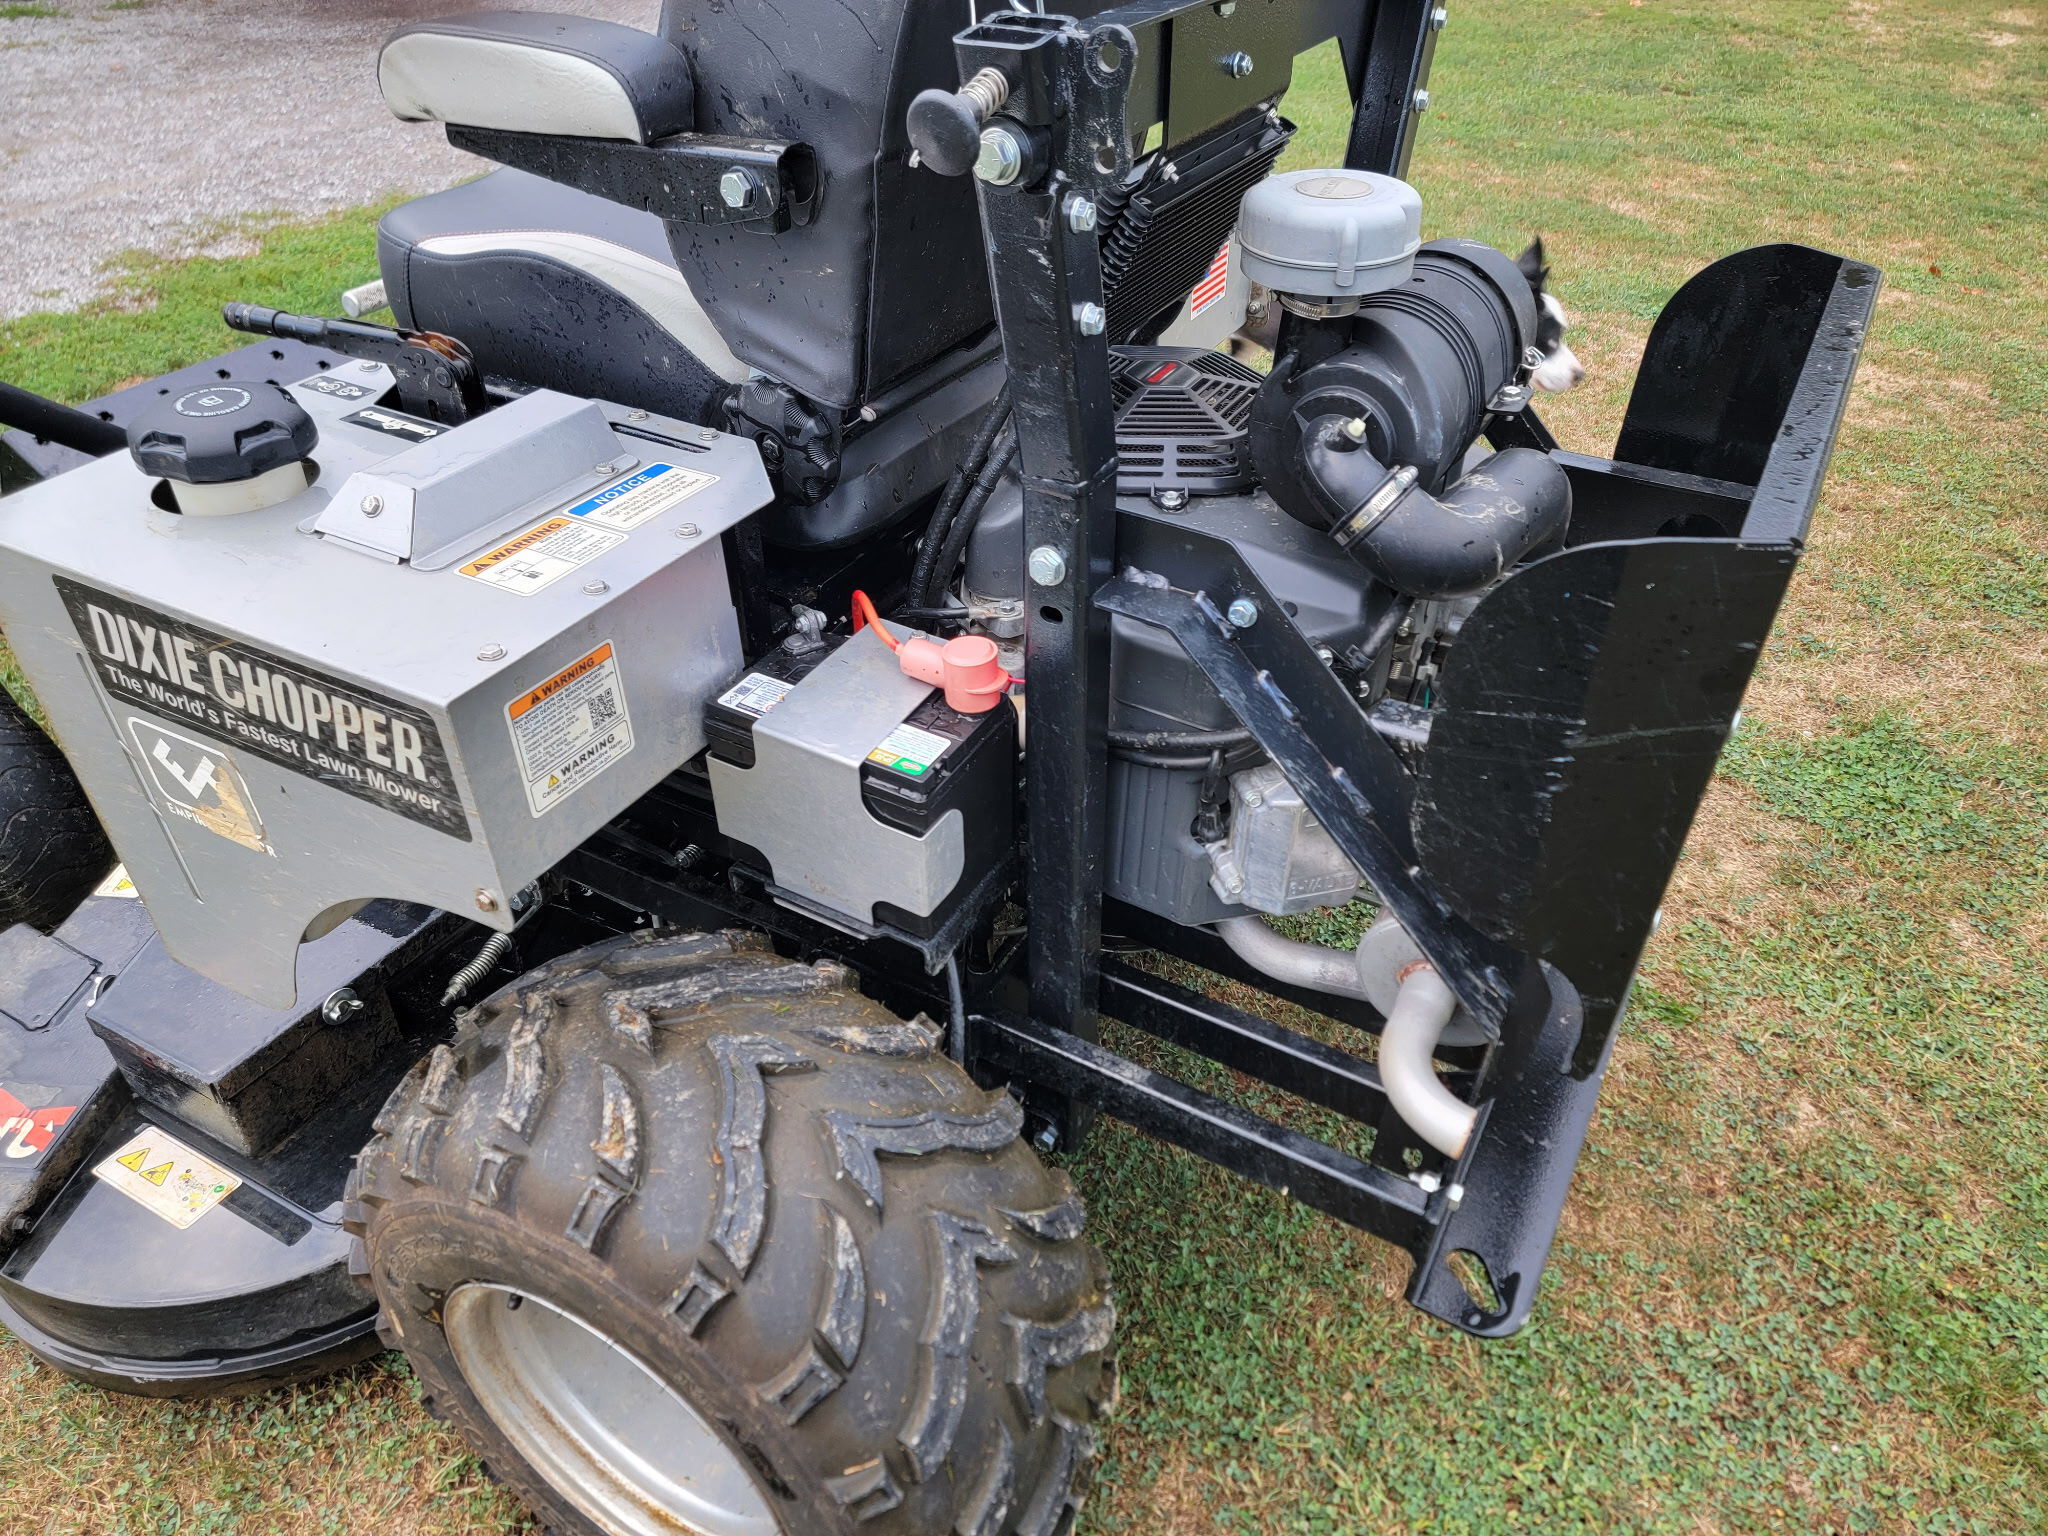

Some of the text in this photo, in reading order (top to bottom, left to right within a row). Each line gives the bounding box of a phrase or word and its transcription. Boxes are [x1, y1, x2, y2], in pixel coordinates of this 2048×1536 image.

[593, 473, 653, 505] NOTICE
[488, 521, 563, 562] WARNING
[86, 602, 428, 783] DIXIE CHOPPER
[541, 656, 595, 697] WARNING
[104, 664, 143, 692] The
[147, 681, 220, 726] World's
[225, 711, 300, 757] Fastest
[303, 742, 362, 782] Lawn
[542, 781, 561, 799] Cancer
[562, 773, 573, 784] and
[573, 748, 607, 776] Reproductive
[608, 738, 622, 751] Harm
[560, 732, 615, 777] WARNING
